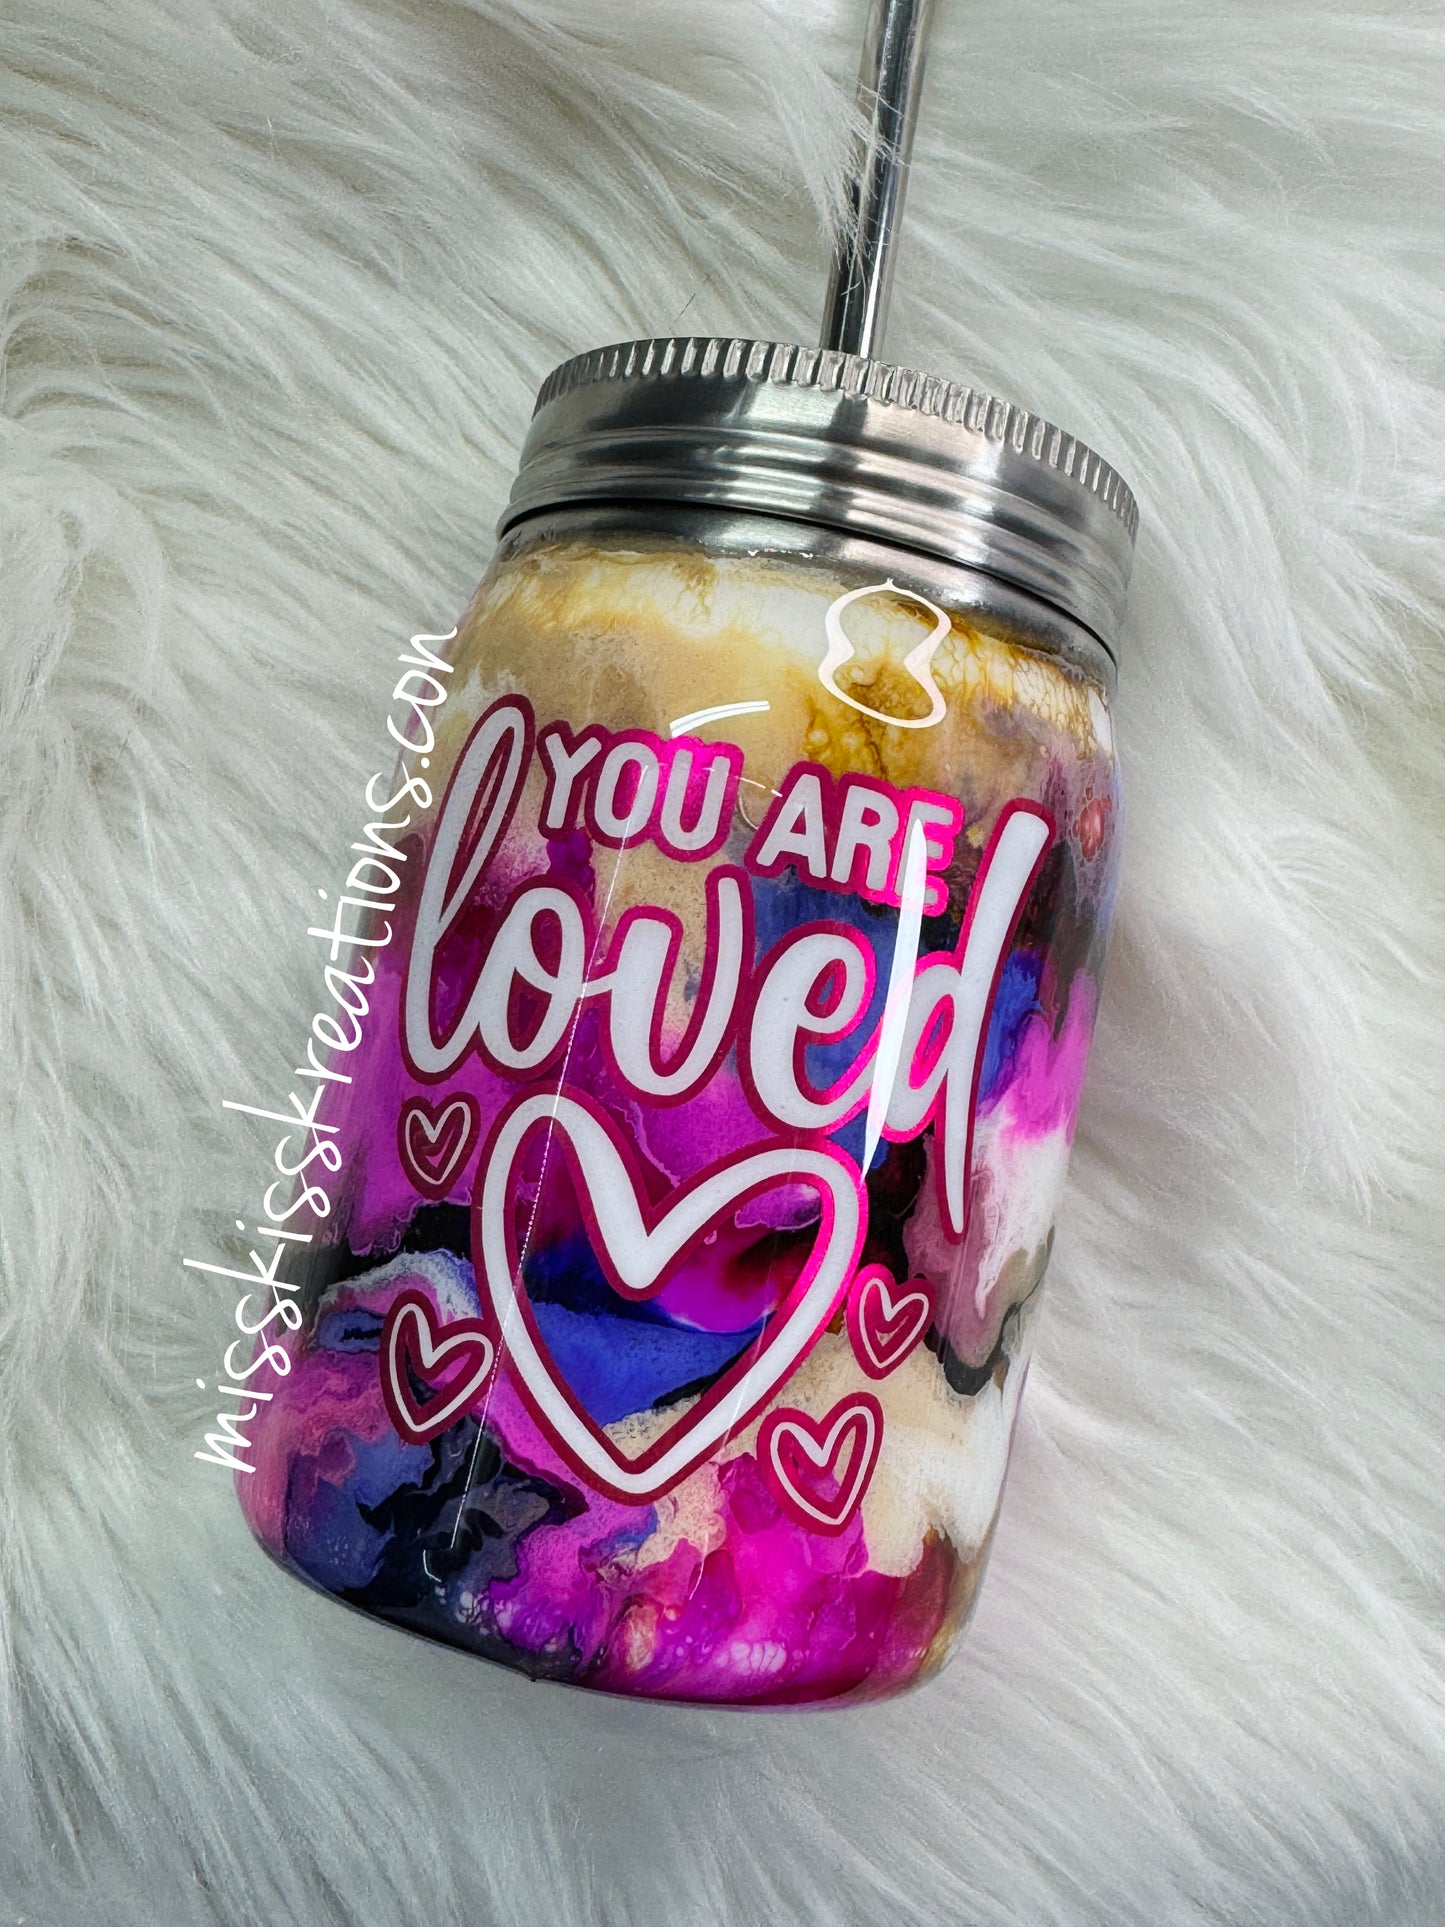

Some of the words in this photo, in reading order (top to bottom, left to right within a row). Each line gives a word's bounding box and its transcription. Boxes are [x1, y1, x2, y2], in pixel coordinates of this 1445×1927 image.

[404, 705, 1051, 1236] loved
[543, 731, 728, 852] YOU
[755, 772, 956, 906] ARE
